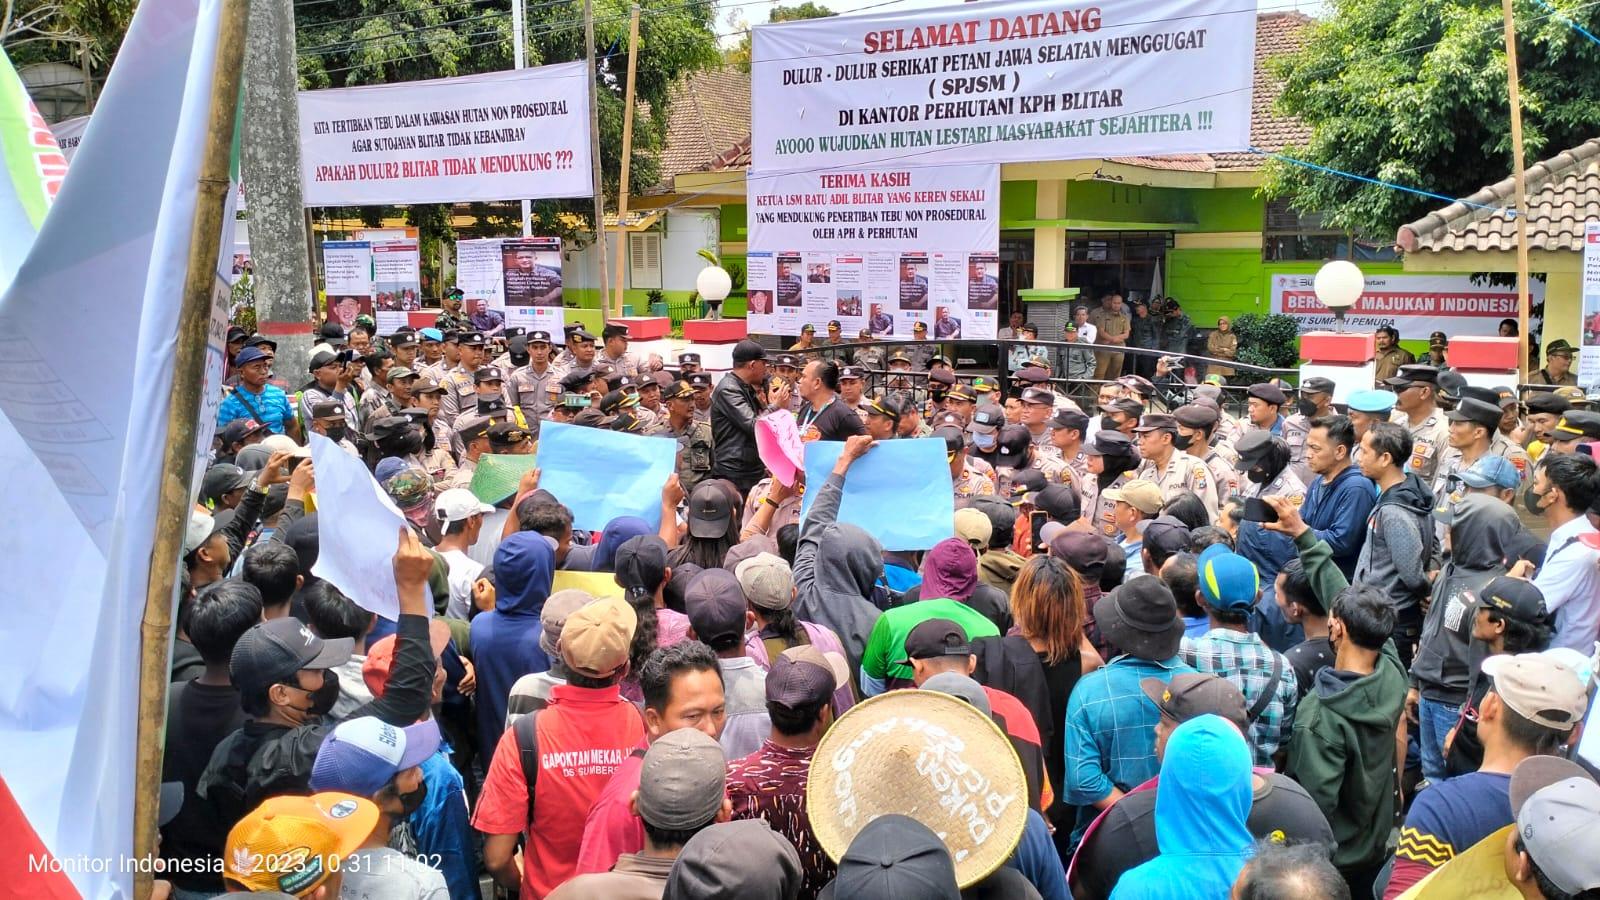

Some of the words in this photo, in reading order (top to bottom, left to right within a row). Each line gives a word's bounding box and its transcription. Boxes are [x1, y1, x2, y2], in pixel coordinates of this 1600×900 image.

[863, 20, 981, 55] SELAMAT
[989, 7, 1102, 43] DATANG
[783, 67, 823, 86] DULUR
[835, 62, 877, 82] DULUR
[881, 56, 938, 78] SERIKAT
[942, 51, 990, 73] PETANI
[995, 47, 1033, 68] JAWA
[1037, 40, 1102, 63] SELATAN
[1106, 29, 1207, 58] MENGGUGAT
[941, 73, 1006, 96] SPJSM
[313, 121, 330, 135] KITA
[332, 118, 373, 134] TERTIBKAN
[375, 115, 394, 130] TEBU
[396, 113, 421, 129] DALAM
[423, 109, 461, 127] KAWASAN
[462, 107, 489, 124] HUTAN
[491, 104, 509, 121] NON
[510, 100, 569, 119] PROSEDURAL
[838, 109, 854, 127] DI
[858, 104, 919, 126] KANTOR
[924, 97, 1014, 121] PERHUTANI
[1019, 92, 1056, 114] KPH
[1061, 88, 1124, 111] BLITAR
[351, 139, 373, 153] AGAR
[374, 136, 417, 152] SUTOJAYAN
[418, 133, 445, 149] BLITAR
[447, 131, 472, 146] TIDAK
[473, 127, 526, 145] KEBANJIRAN
[775, 137, 815, 155] AYOOO
[818, 132, 887, 153] WUJUDKAN
[890, 129, 933, 149] HUTAN
[936, 125, 992, 146] LESTARI
[995, 118, 1095, 143] MASYARAKAT
[1099, 111, 1193, 136] SEJAHTERA
[1197, 110, 1213, 131] !!!
[315, 163, 356, 182] APAKAH
[359, 161, 399, 180] DULUR2
[402, 159, 439, 178] BLITAR
[443, 157, 478, 176] TIDAK
[480, 152, 552, 174] MENDUKUNG
[555, 150, 574, 170] ???
[819, 174, 866, 189] TERIMA
[871, 171, 911, 187] KASIH
[756, 194, 783, 206] KETUA
[785, 194, 802, 206] LSM
[805, 194, 827, 206] RATU
[829, 193, 850, 205] ADIL
[852, 193, 884, 205] BLITAR
[886, 191, 911, 204] YANG
[914, 190, 947, 203] KEREN
[950, 189, 985, 202] SEKALI
[756, 211, 775, 224] YANG
[777, 211, 825, 223] MENDUKUNG
[827, 210, 878, 223] PENERTIBAN
[881, 210, 902, 222] TEBU
[905, 209, 923, 221] NON
[925, 208, 987, 221] PROSEDURAL
[812, 227, 835, 240] OLEH
[837, 227, 855, 239] APH
[867, 227, 918, 240] PERHUTANI
[1361, 297, 1435, 312] MAJUKAN
[1308, 316, 1350, 325] SUMPH
[1351, 317, 1396, 327] PEMUDA
[542, 751, 590, 770] GAPOKTAN
[590, 749, 622, 765] MEKAR
[578, 765, 620, 776] SUMBERS
